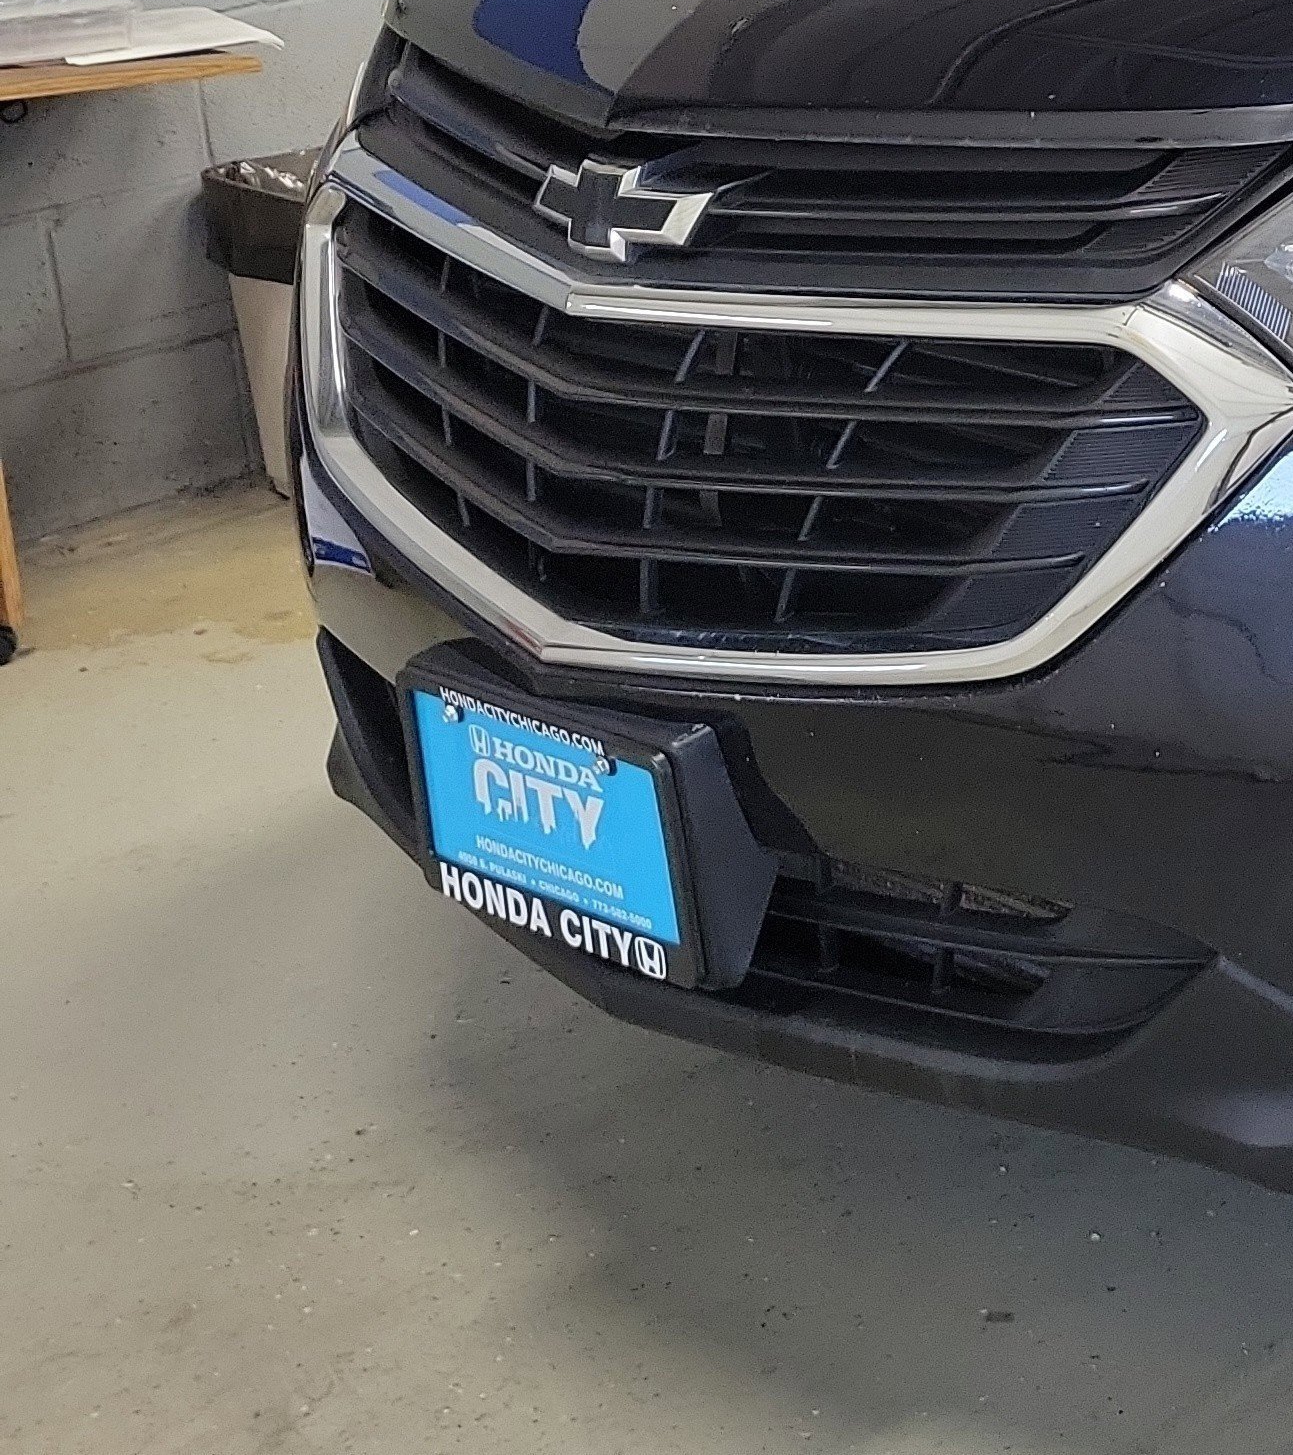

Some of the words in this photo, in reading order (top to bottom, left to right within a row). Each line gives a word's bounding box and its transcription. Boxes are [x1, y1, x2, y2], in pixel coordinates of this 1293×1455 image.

[440, 686, 605, 756] HONDACITYCHICAGO.COM
[491, 737, 603, 793] HONDA
[474, 758, 604, 850] CITY
[476, 835, 624, 901] HONDACITYCHICAGO.COM
[538, 879, 580, 904] CHICAGO
[440, 861, 552, 938] HONDA
[560, 909, 633, 967] CITY
